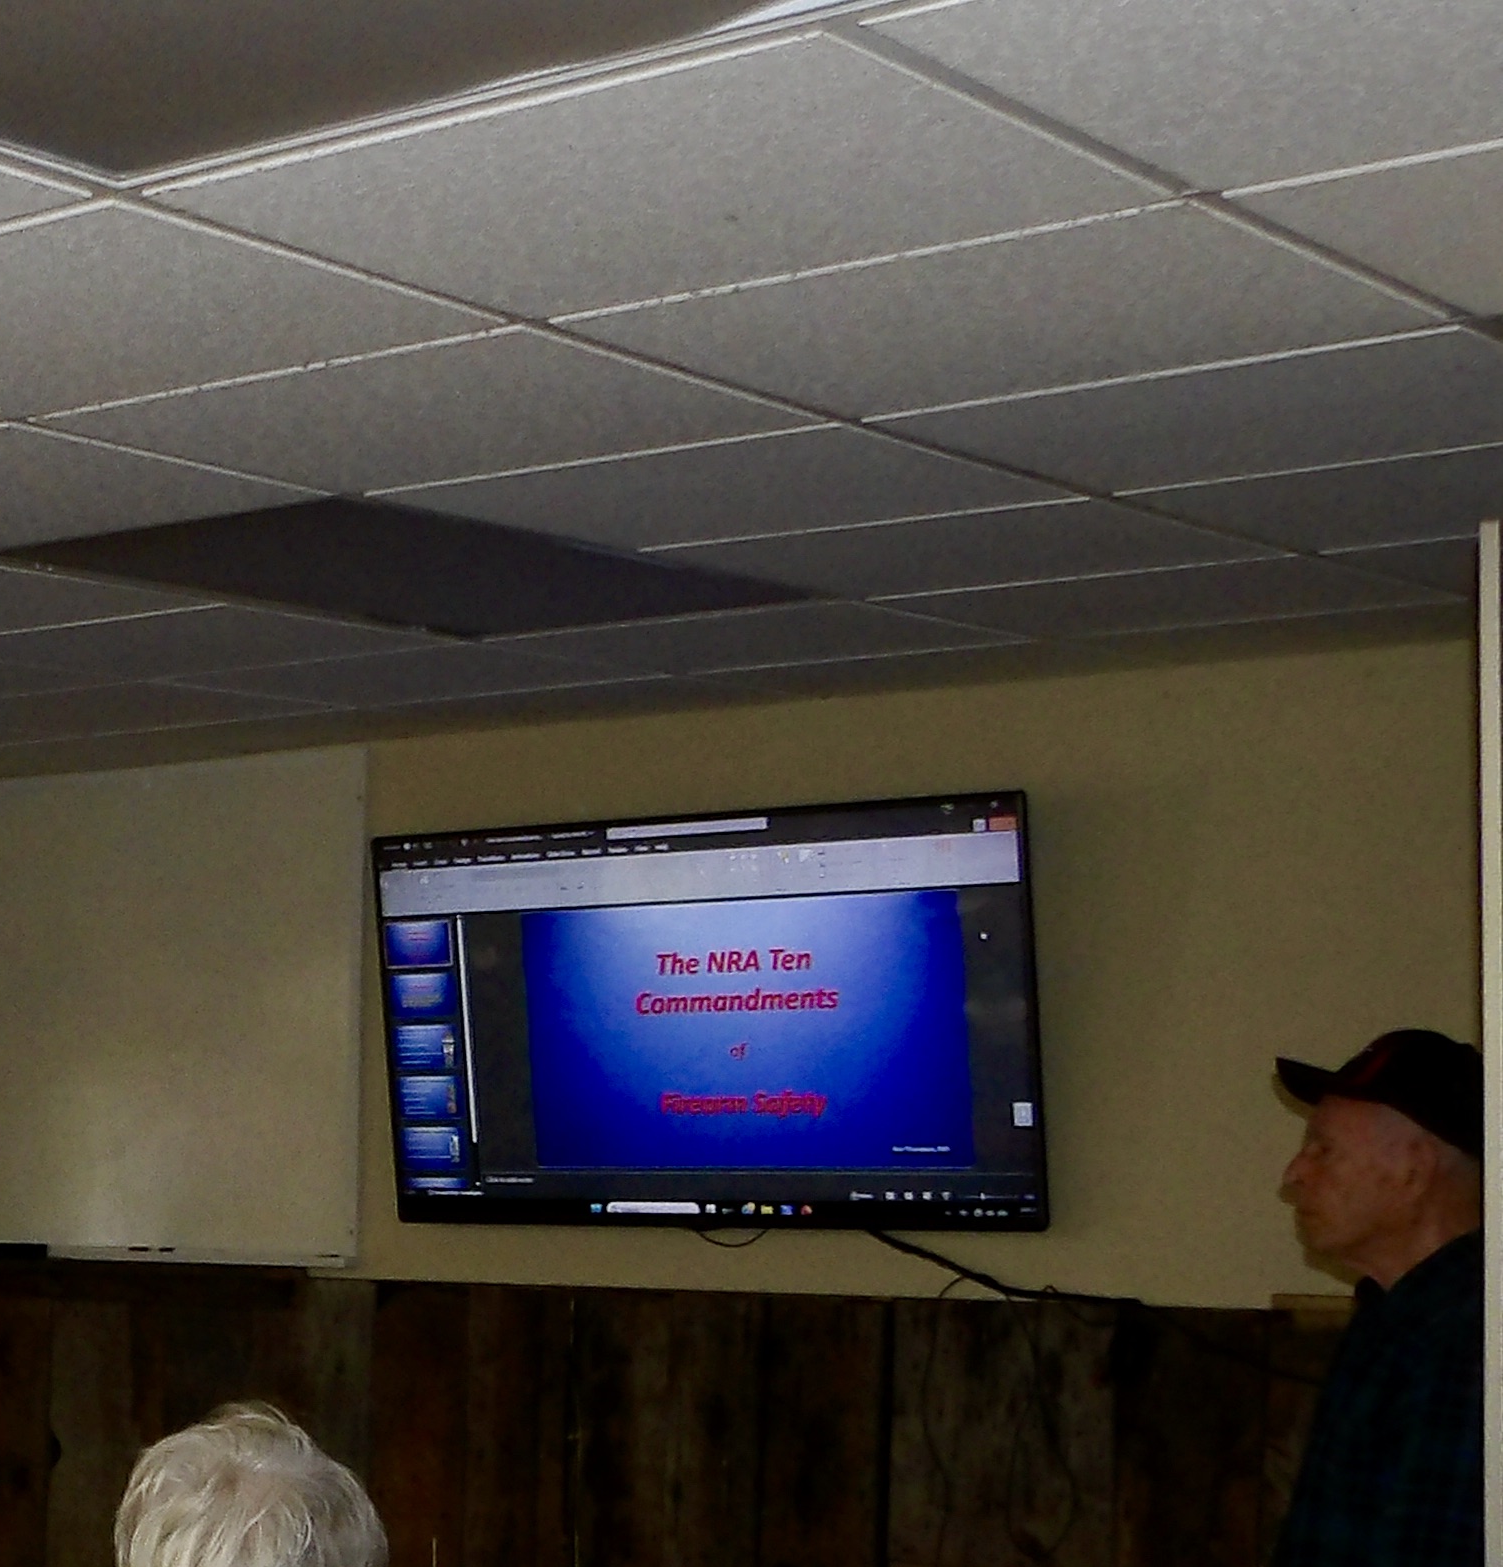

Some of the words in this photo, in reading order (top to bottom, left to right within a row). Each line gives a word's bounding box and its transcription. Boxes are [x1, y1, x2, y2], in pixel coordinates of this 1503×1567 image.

[657, 953, 699, 975] The
[707, 951, 760, 973] NRA
[769, 949, 811, 970] Ten
[636, 988, 839, 1015] Commandments
[729, 1043, 747, 1060] of
[753, 1090, 828, 1119] Safety
